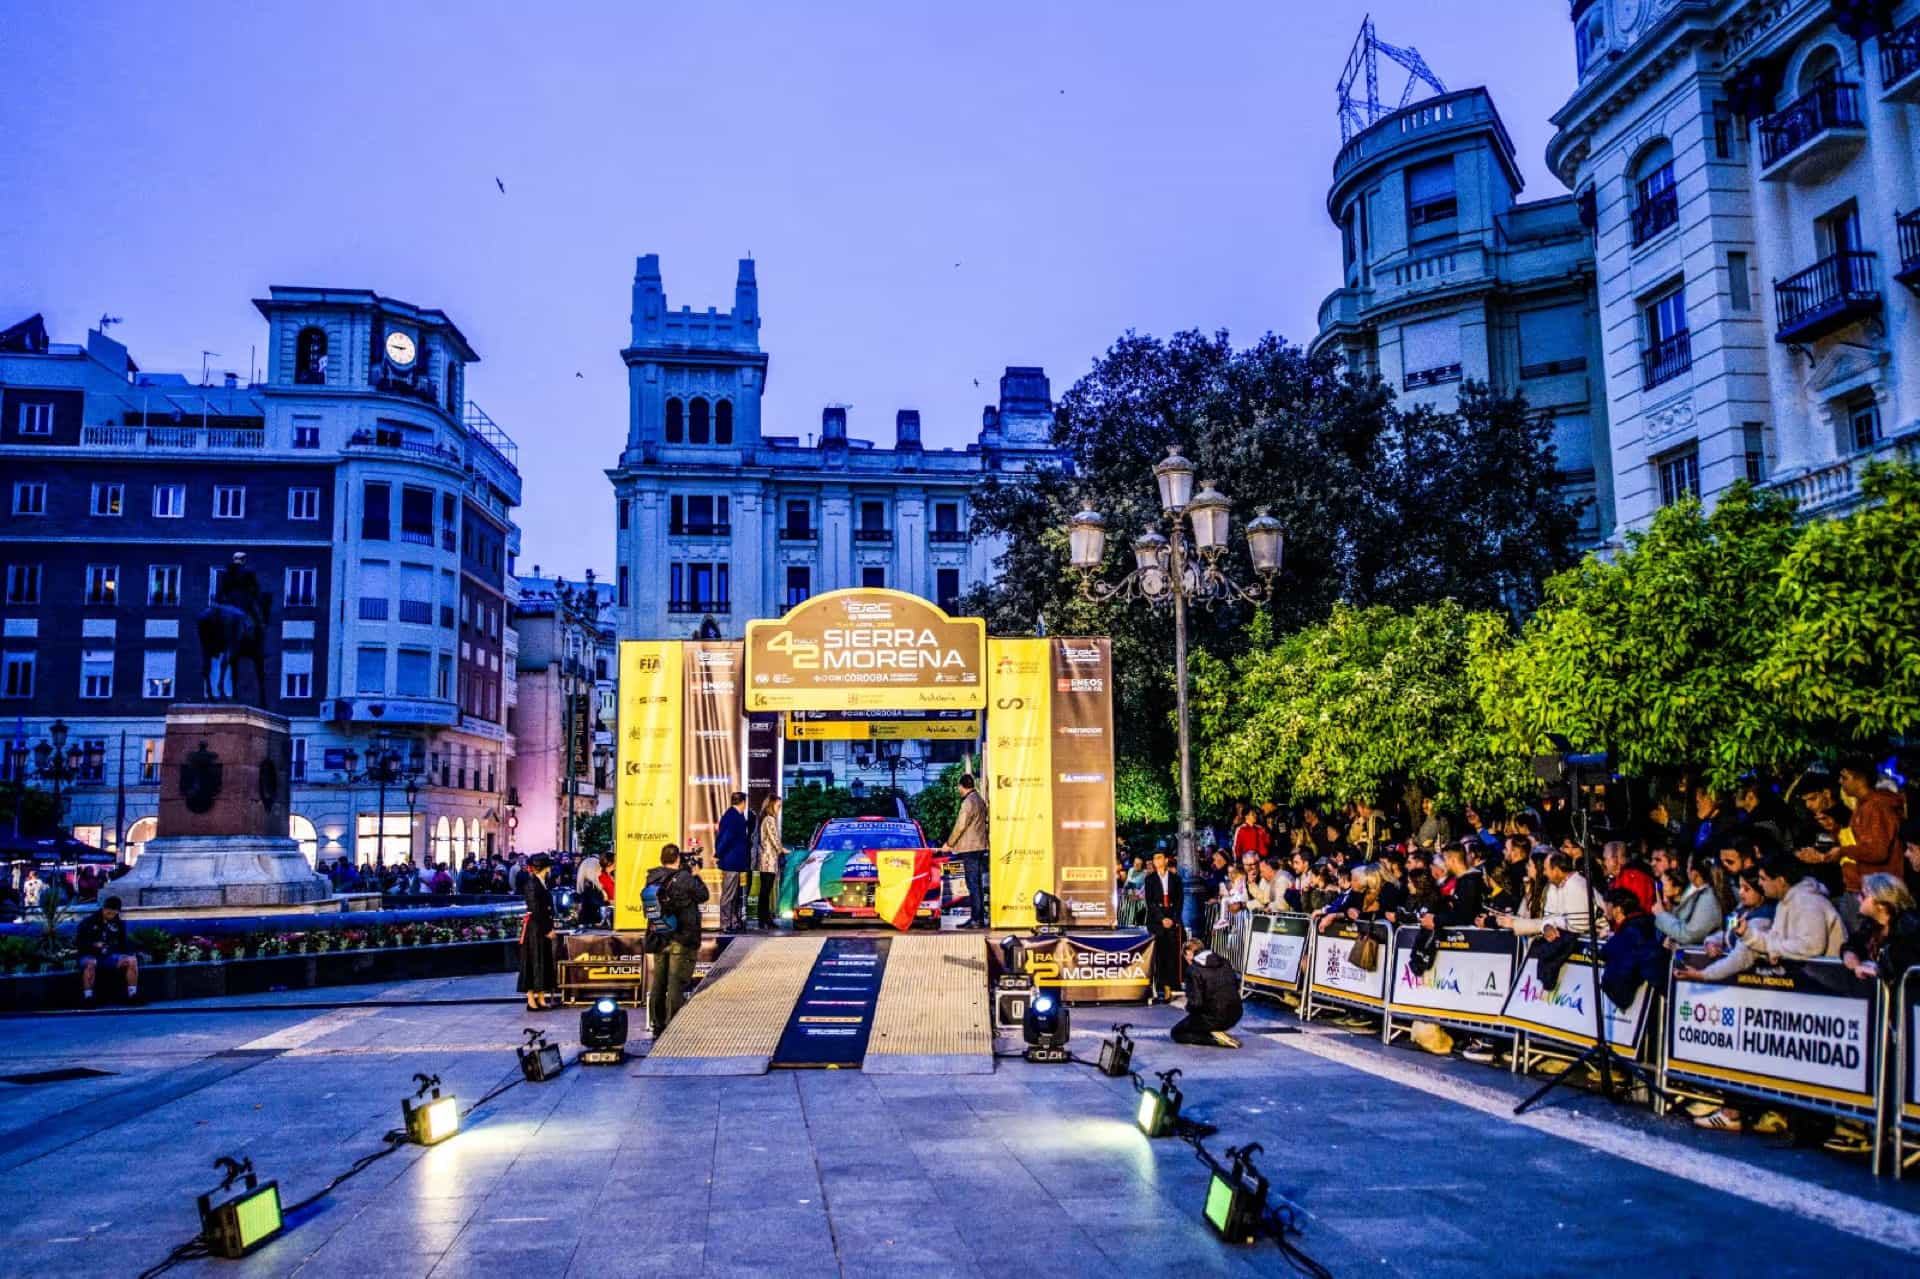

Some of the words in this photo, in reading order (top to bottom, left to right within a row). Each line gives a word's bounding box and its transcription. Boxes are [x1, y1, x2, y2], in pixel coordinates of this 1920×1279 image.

[823, 629, 939, 649] SIERRA
[823, 650, 966, 669] MORENA
[1077, 952, 1145, 964] SIERRA
[609, 967, 641, 975] MOR
[1063, 967, 1146, 980] MORENA
[1744, 1007, 1845, 1038] PATRIMONIO
[1848, 1020, 1860, 1031] DE
[1679, 1026, 1733, 1049] CÓRDOBA
[1848, 1031, 1859, 1041] LA
[1743, 1030, 1860, 1070] HUMANIDAD
